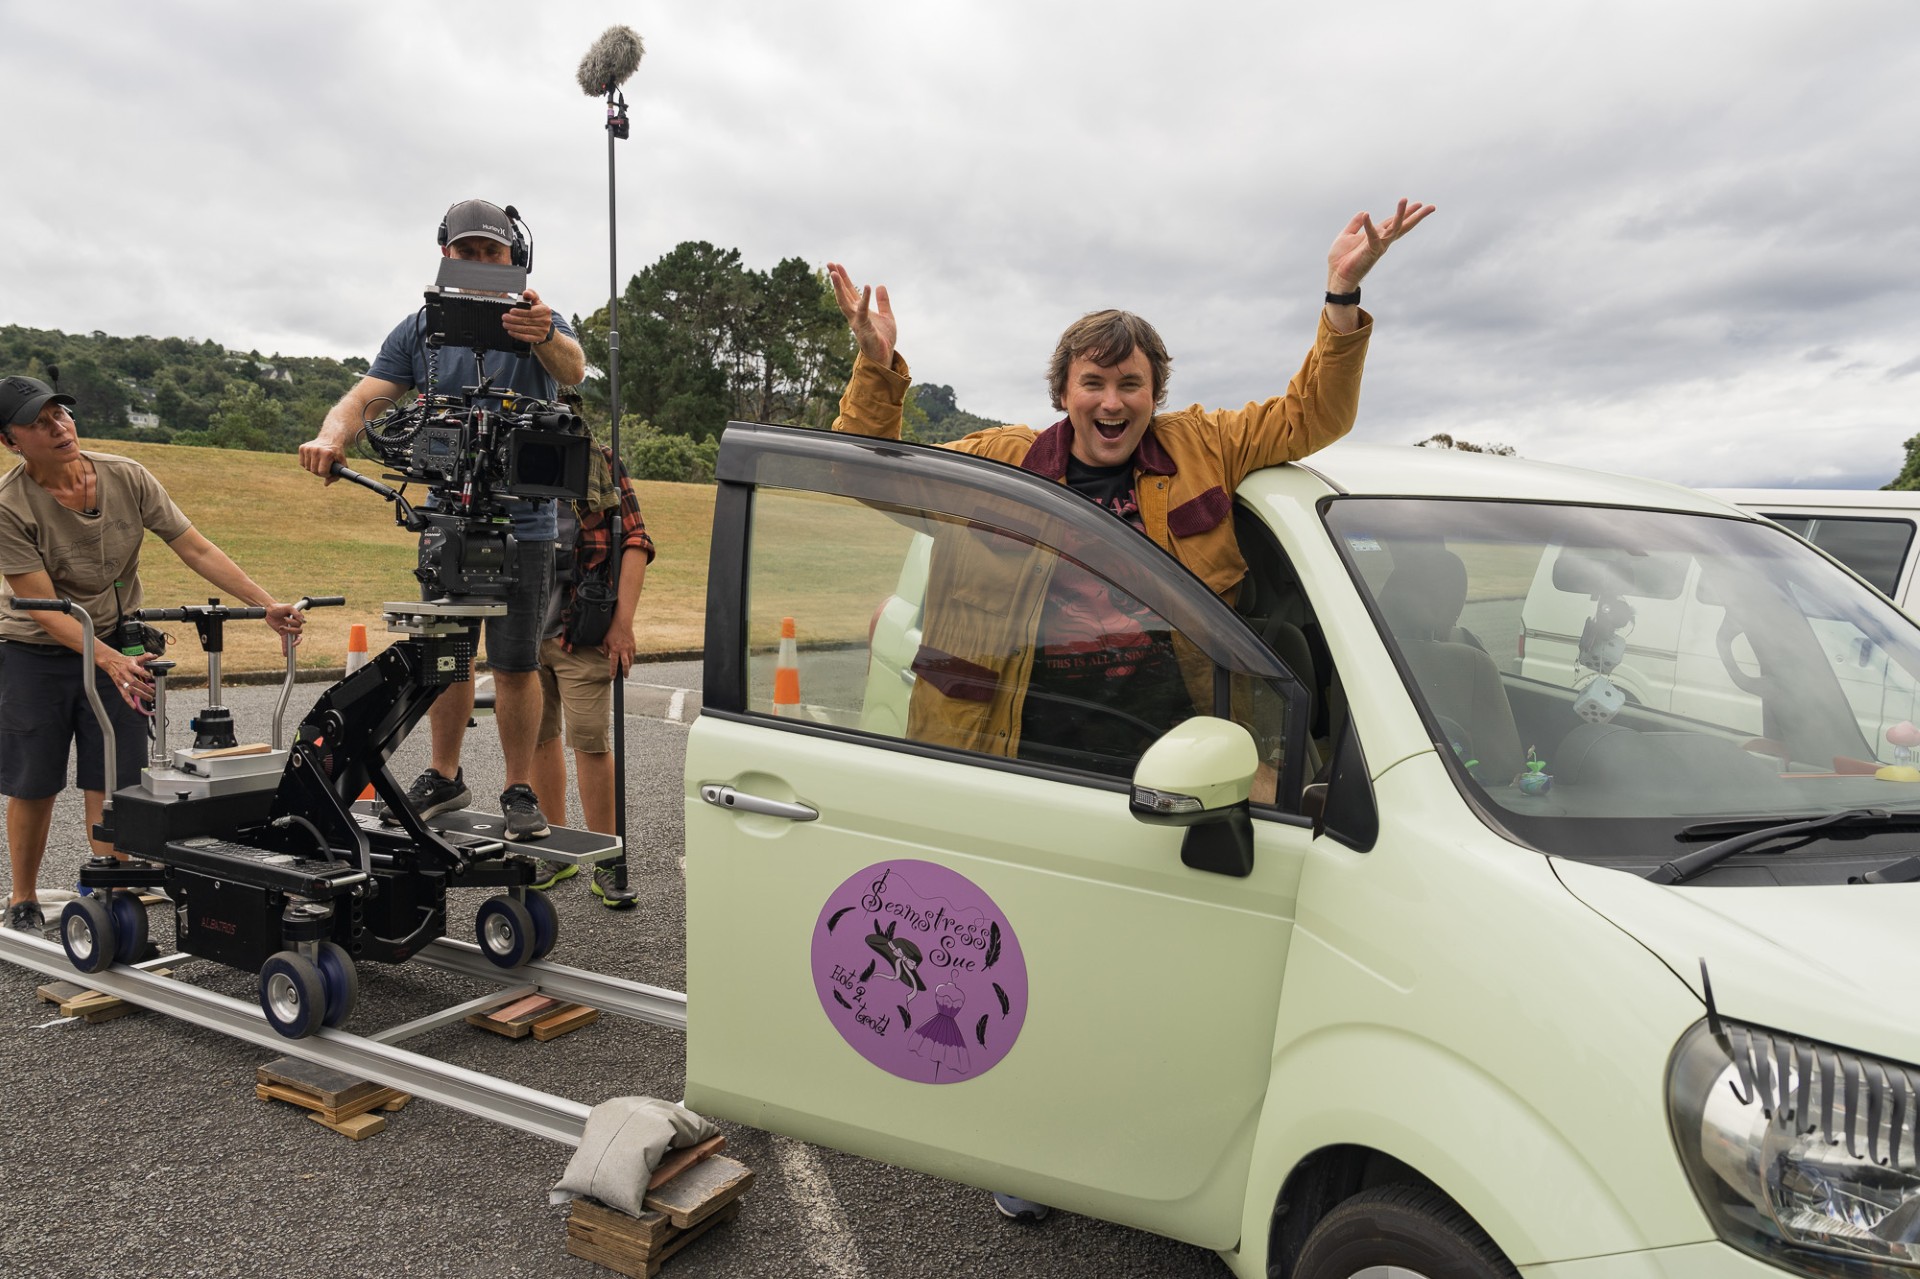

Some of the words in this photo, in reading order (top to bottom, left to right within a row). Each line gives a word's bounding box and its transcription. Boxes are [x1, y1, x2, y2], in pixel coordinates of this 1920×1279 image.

[482, 223, 501, 233] Hurley
[861, 873, 990, 950] Seamstress
[929, 935, 976, 972] Sue
[830, 964, 857, 990] Hot
[852, 986, 866, 1003] 2
